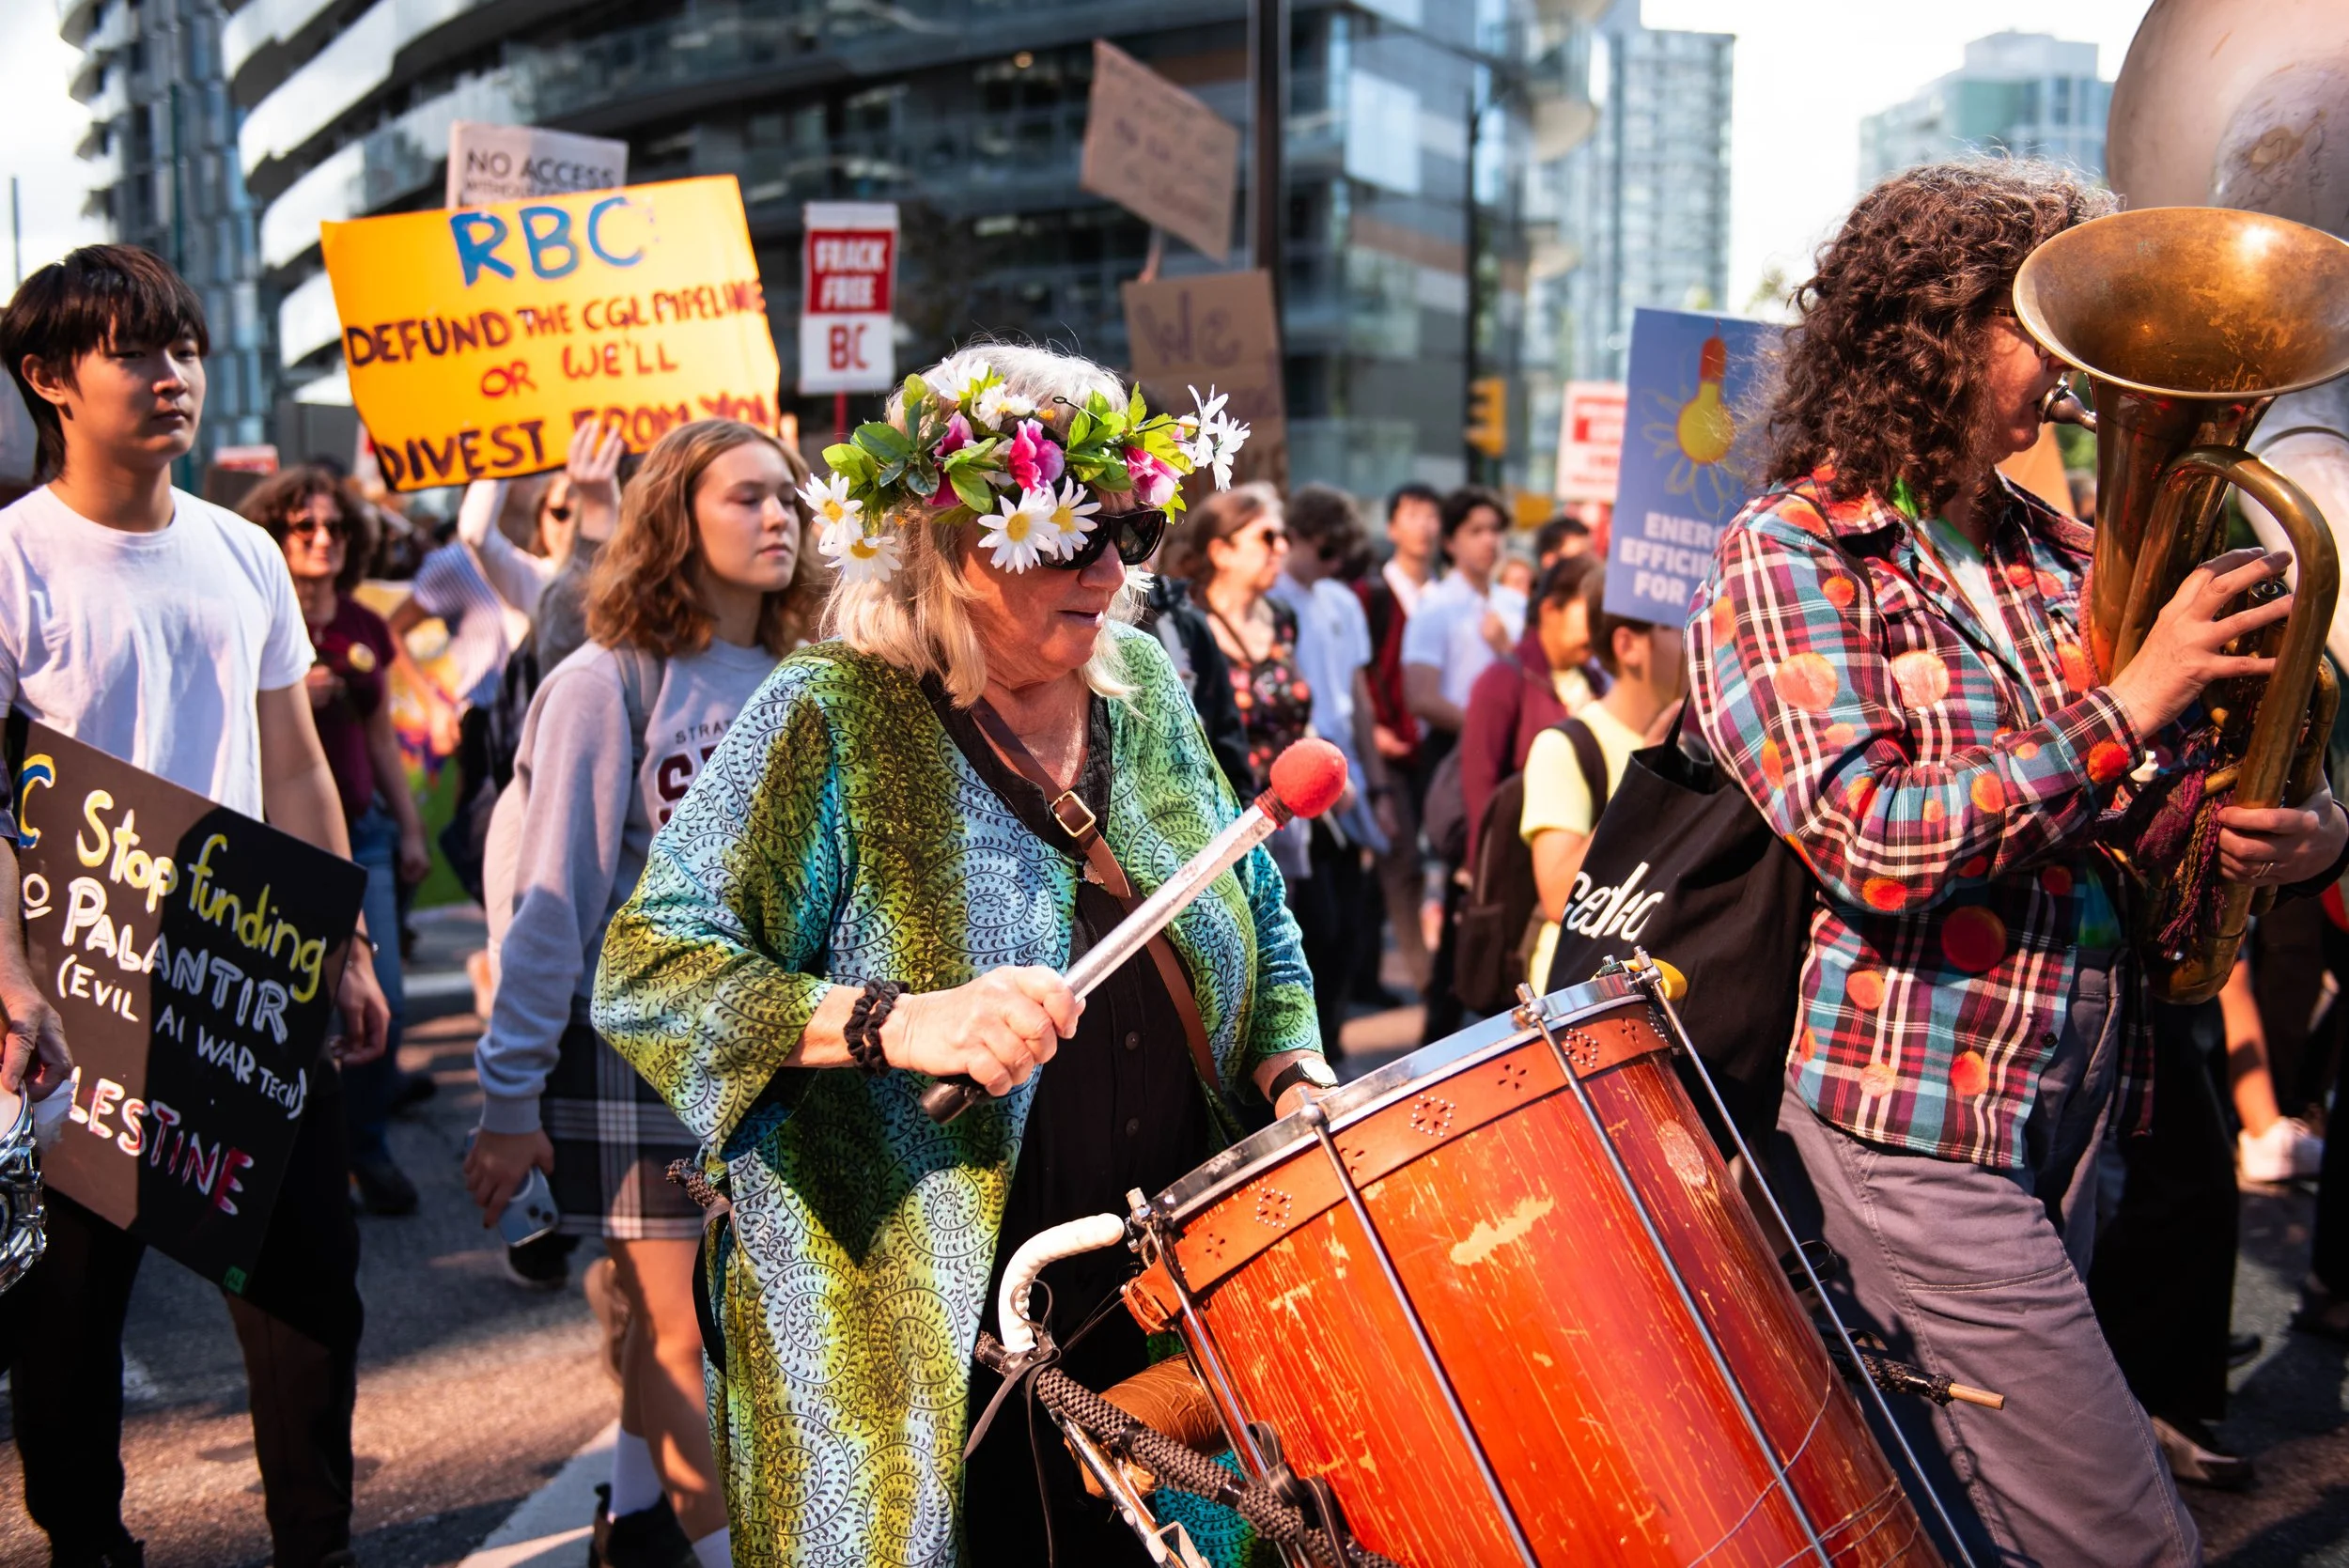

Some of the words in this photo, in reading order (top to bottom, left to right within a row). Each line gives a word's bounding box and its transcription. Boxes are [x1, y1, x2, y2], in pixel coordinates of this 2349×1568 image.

[467, 148, 512, 179] NO
[521, 154, 615, 189] ACCESS
[449, 195, 645, 286] RBC
[814, 238, 887, 273] FRACK
[819, 274, 876, 309] FREE
[346, 311, 513, 367] DEFUND
[517, 303, 572, 336] THE
[583, 295, 648, 331] CGL
[829, 323, 870, 370] BC
[481, 361, 537, 397] OR
[563, 339, 678, 380] WE'LL
[379, 419, 545, 483] DIVEST
[1633, 569, 1687, 606] FOR
[76, 789, 179, 914] Stop
[187, 833, 327, 1003] funding
[62, 877, 289, 1044] PALANTIR
[57, 954, 140, 1023] (EVIL
[155, 1004, 186, 1043] AI
[197, 1025, 257, 1084] WAR
[258, 1064, 308, 1120] TECH)
[69, 1066, 255, 1216] LESTINE
